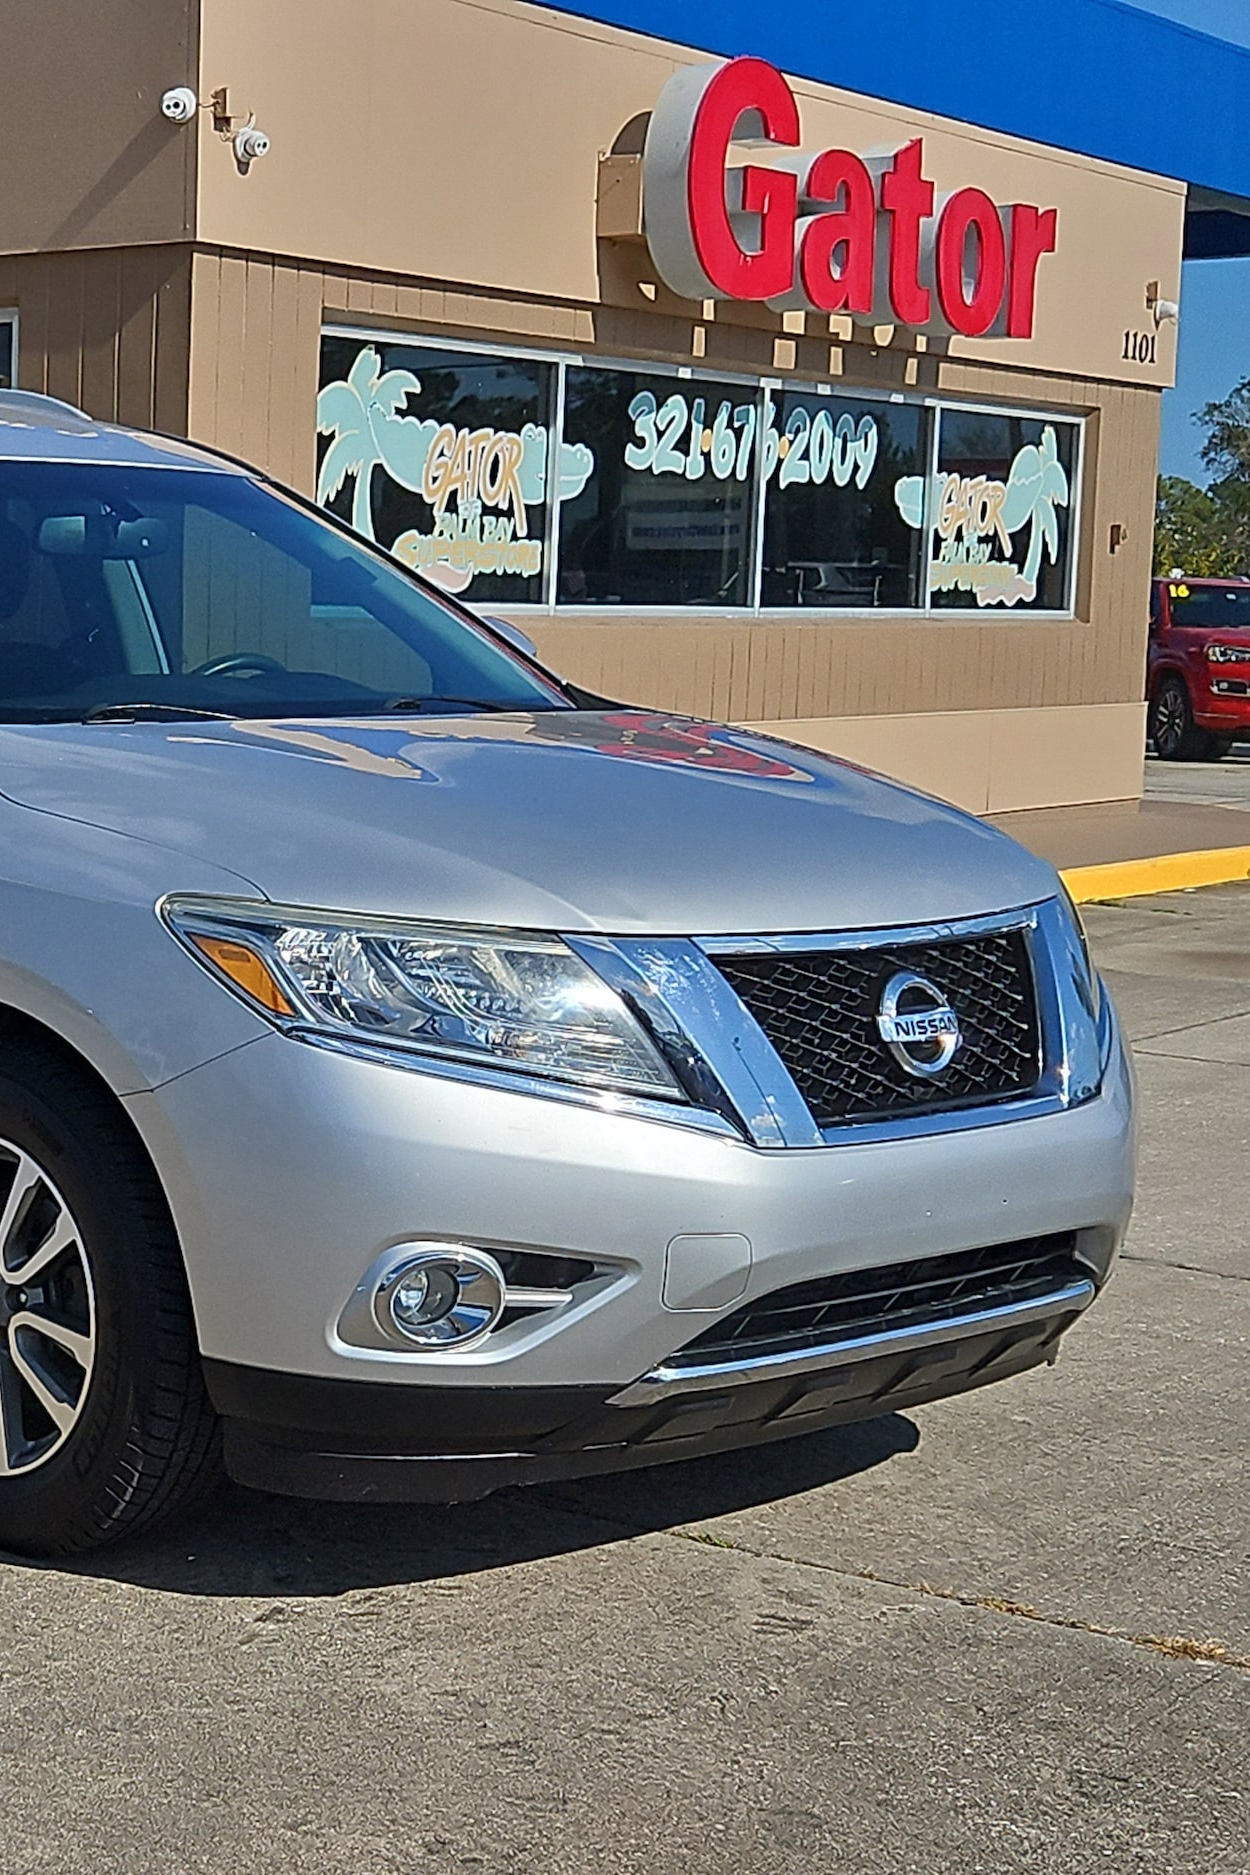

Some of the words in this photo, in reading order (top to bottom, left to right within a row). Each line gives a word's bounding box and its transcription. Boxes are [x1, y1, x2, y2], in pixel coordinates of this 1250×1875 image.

[685, 55, 1058, 340] Gator
[1121, 329, 1157, 365] 1101
[422, 423, 528, 538] GATOR
[938, 473, 1014, 558] GATOR
[1168, 583, 1190, 598] 16
[893, 1014, 958, 1037] NISSAN
